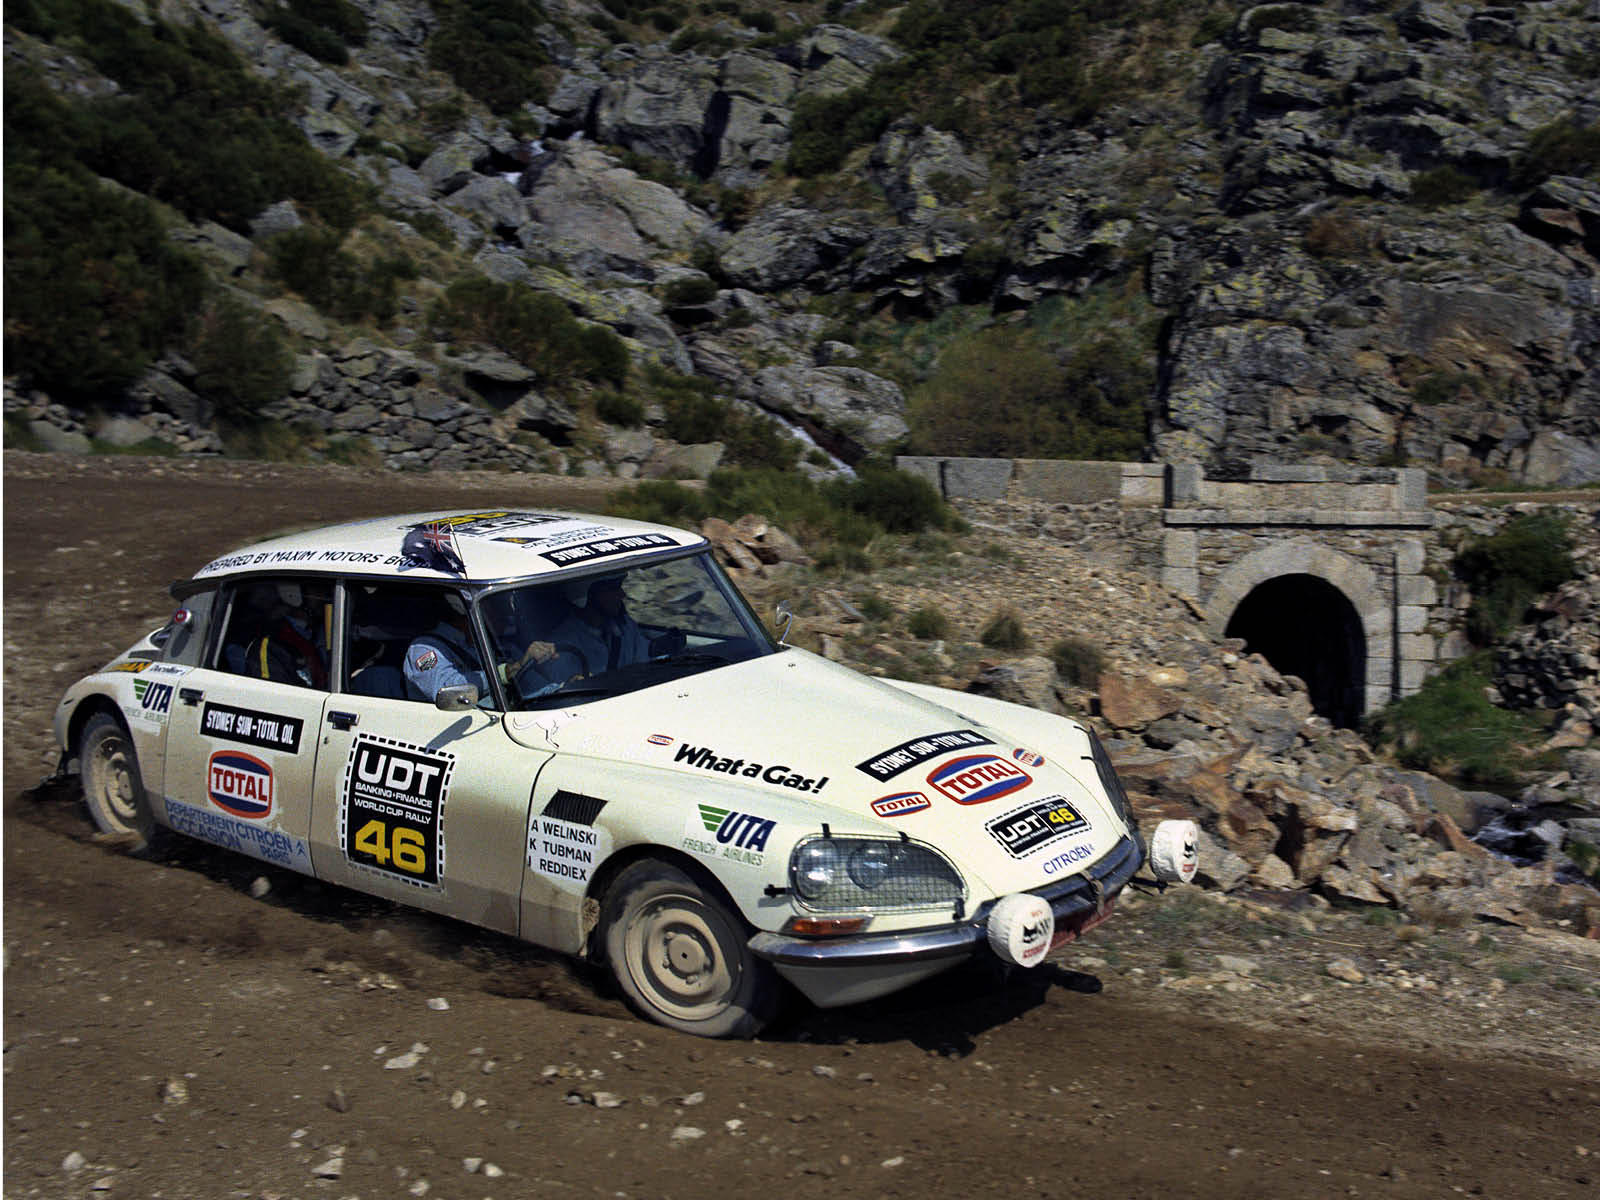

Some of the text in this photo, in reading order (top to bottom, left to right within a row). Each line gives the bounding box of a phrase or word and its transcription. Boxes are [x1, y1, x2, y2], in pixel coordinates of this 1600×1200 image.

[201, 554, 252, 574] PREPARED
[253, 552, 273, 565] BY
[272, 550, 314, 563] MAXIM
[319, 551, 383, 564] MOTORS
[142, 681, 174, 713] UTA
[206, 710, 236, 733] SYDNEY
[281, 723, 294, 745] OIL
[358, 750, 441, 796] UDT
[673, 743, 830, 794] What a Gas!
[870, 748, 917, 775] SYDNEY
[213, 767, 268, 803] TOTAL
[941, 762, 1021, 795] TOTAL
[354, 798, 432, 825] WORLD CUP RALLY
[876, 796, 926, 812] TOTAL
[1049, 808, 1076, 824] 46
[531, 819, 597, 846] A WELINSKI
[716, 811, 778, 852] UTA
[997, 814, 1042, 843] UDT
[355, 819, 426, 874] 46
[529, 838, 592, 864] K TUBMAN
[683, 838, 764, 866] FRENCH AIRLINES
[539, 858, 587, 881] REDDIEX
